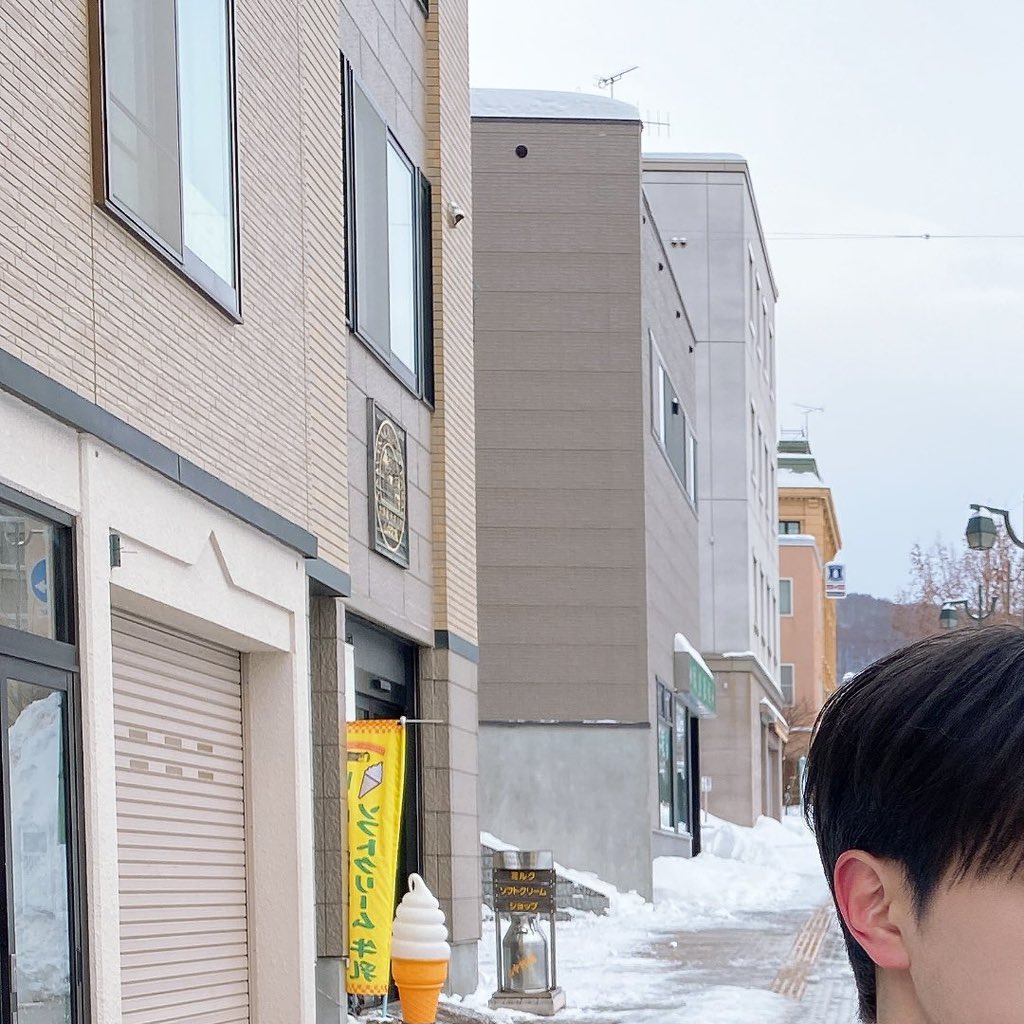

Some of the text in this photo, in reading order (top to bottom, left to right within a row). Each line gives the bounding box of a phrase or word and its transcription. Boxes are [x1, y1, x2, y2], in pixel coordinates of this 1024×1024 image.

[511, 871, 536, 881] ミルク
[500, 886, 547, 897] ソフトクリーム
[510, 902, 539, 911] ショップ
